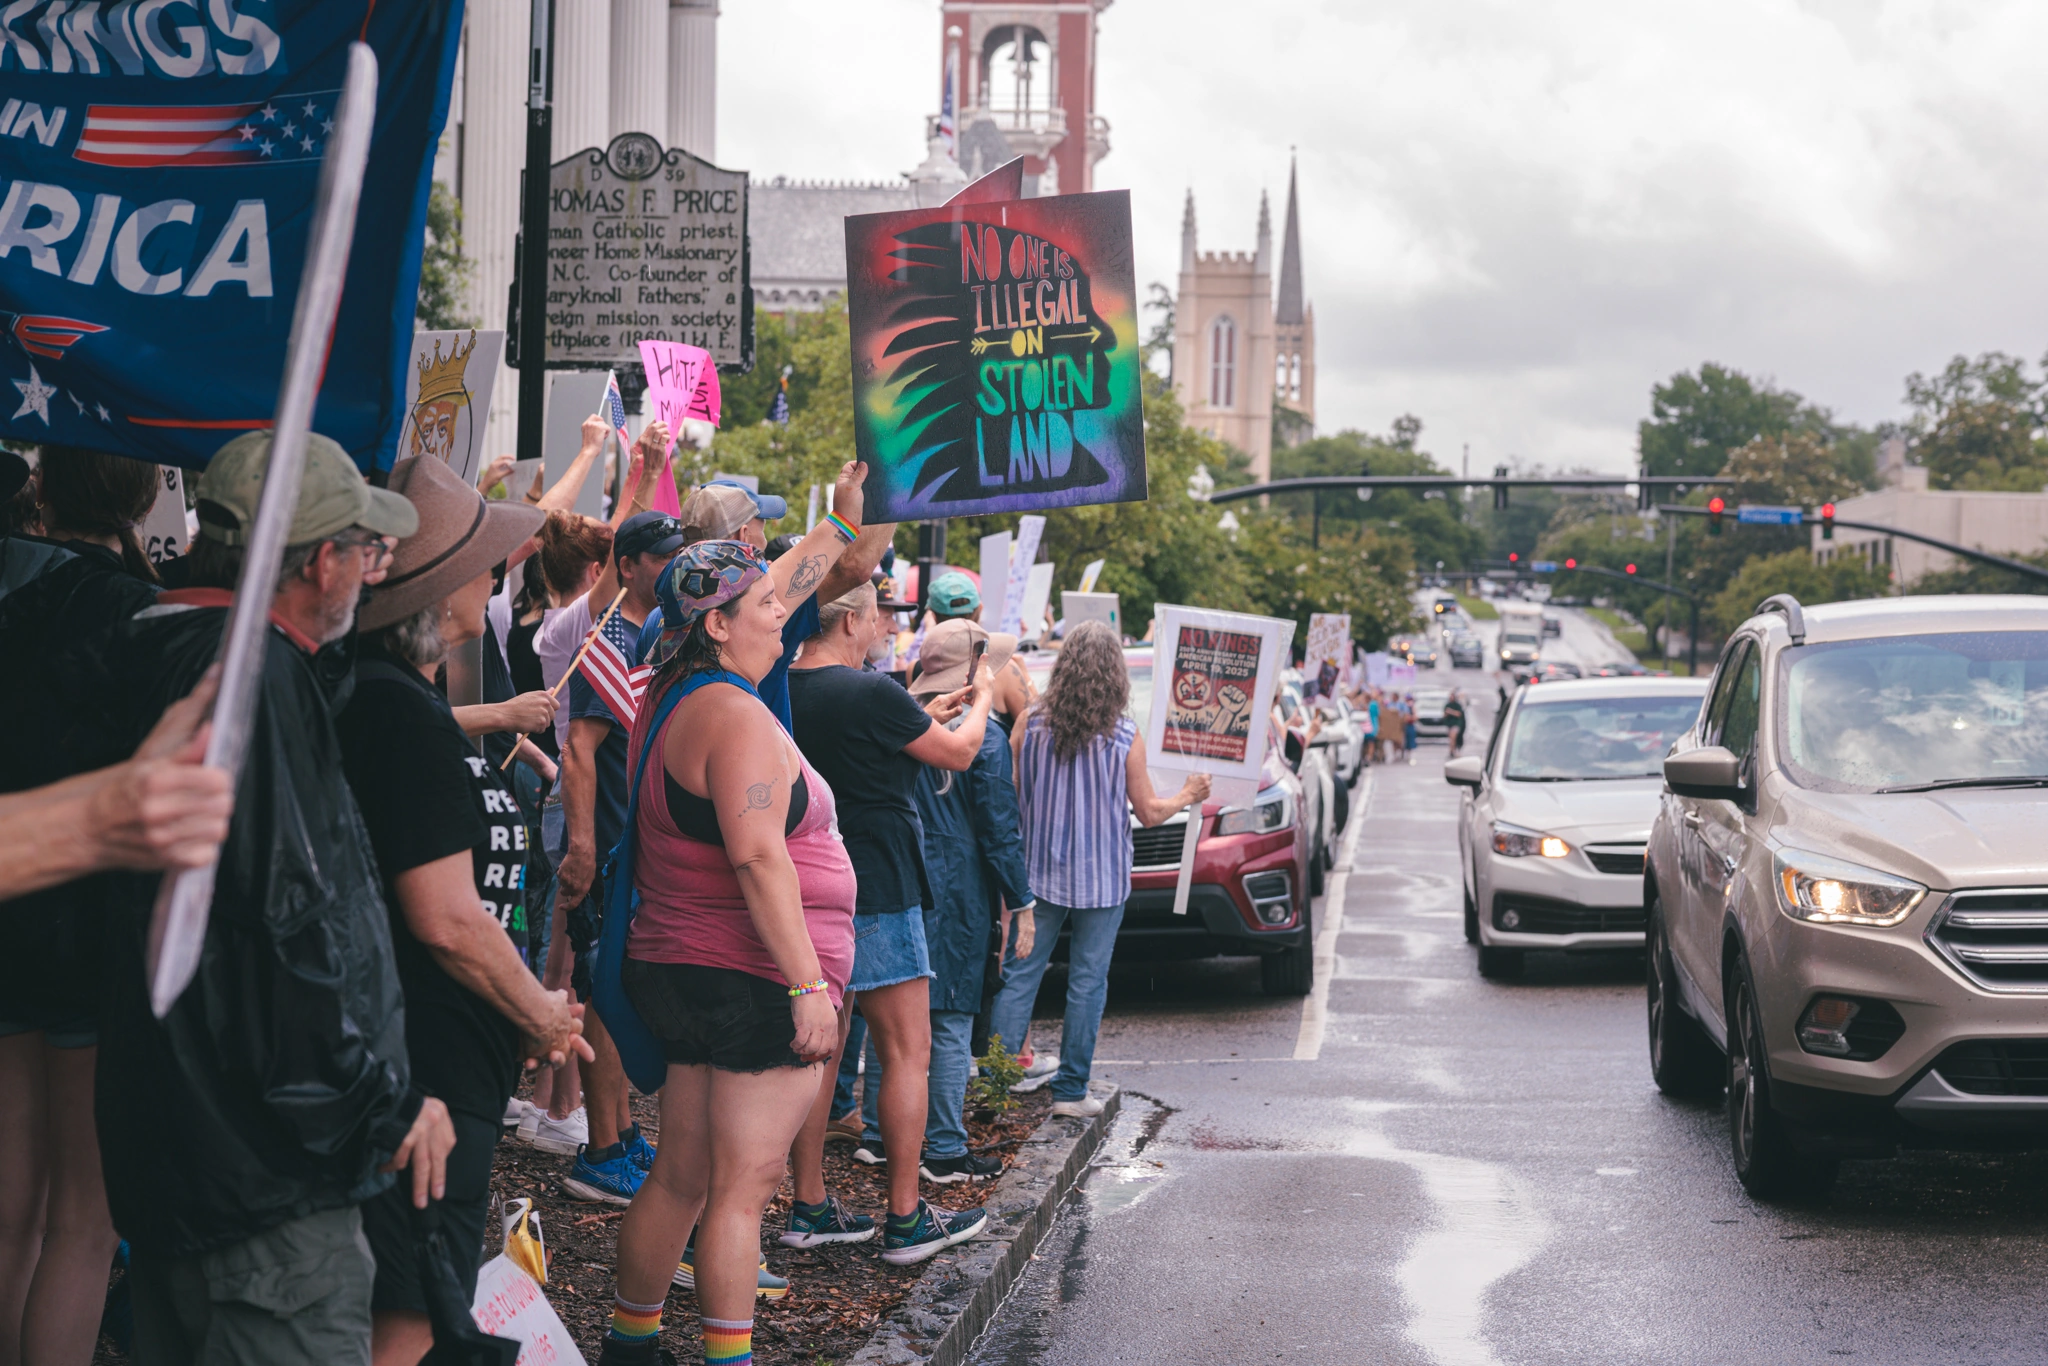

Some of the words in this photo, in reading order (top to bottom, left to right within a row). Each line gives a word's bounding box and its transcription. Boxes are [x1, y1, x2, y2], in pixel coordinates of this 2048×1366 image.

[0, 98, 67, 147] IN
[591, 169, 602, 182] D
[665, 169, 685, 182] 39
[550, 188, 625, 213] HOMAS
[642, 189, 656, 213] F.
[673, 189, 738, 213] PRICE
[0, 180, 273, 297] RICA
[549, 227, 583, 240] man
[592, 221, 665, 240] Catholic
[549, 247, 589, 260] neer
[594, 242, 640, 260] Home
[644, 242, 737, 264] Missionary
[960, 223, 1002, 283] NO
[1008, 233, 1050, 280] ONE
[1053, 250, 1074, 280] IS
[608, 264, 708, 282] Co-founder
[718, 265, 737, 283] of
[548, 285, 622, 307] aryknoll
[726, 293, 736, 304] a
[970, 278, 1088, 334] ILLEGAL
[546, 310, 584, 328] eign
[596, 310, 660, 326] mission
[671, 310, 736, 330] society.
[546, 329, 610, 350] thplace
[1010, 325, 1043, 357] ON
[975, 354, 1094, 416] STOLEN
[975, 411, 1074, 486] LAND
[1180, 627, 1205, 648] NO
[1207, 630, 1260, 655] KINGS
[1178, 651, 1213, 663] AMERICAN
[1182, 660, 1208, 672] APRIL
[1225, 666, 1249, 677] 2025
